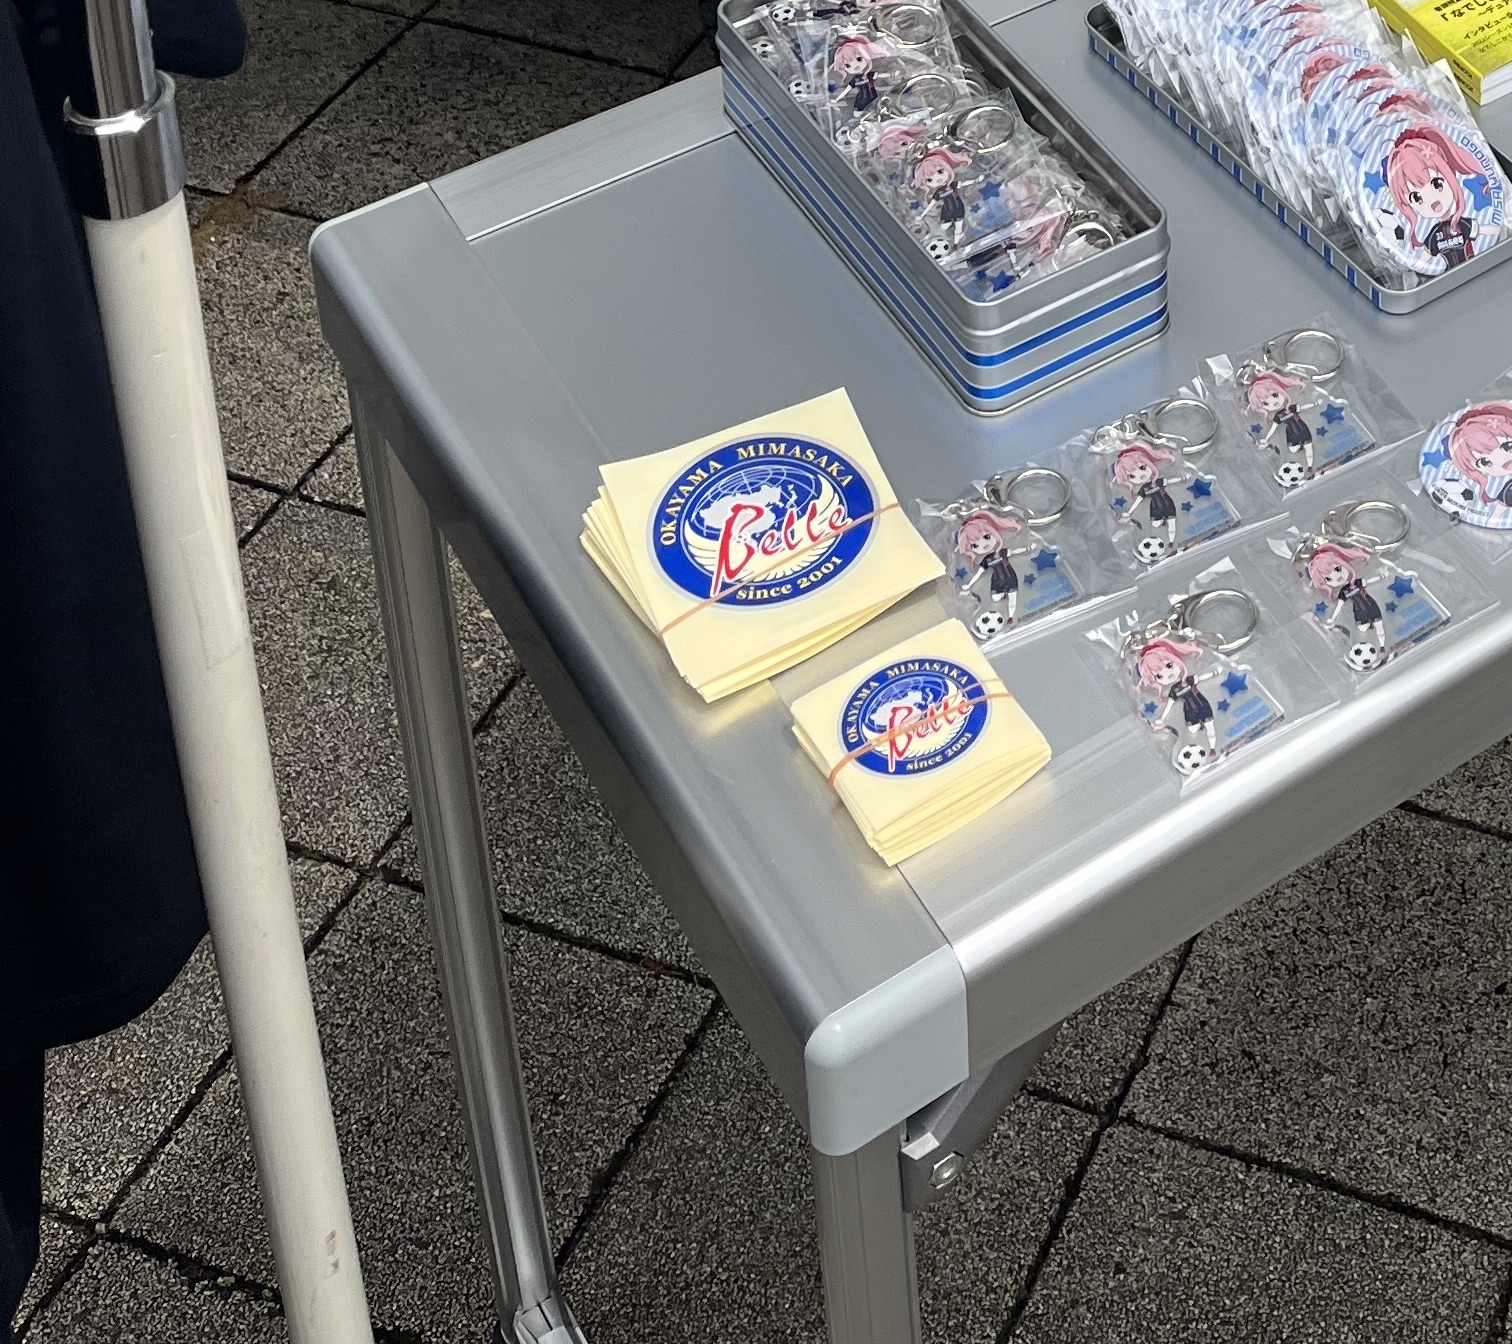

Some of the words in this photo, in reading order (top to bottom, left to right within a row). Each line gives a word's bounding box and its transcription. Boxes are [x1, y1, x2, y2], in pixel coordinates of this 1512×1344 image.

[659, 459, 724, 546] OKAYAMA
[736, 443, 854, 488] MIMASAKA
[709, 502, 854, 598] Belle
[735, 580, 793, 601] since
[797, 555, 844, 590] 2001
[847, 680, 880, 744] OKAYAMA
[887, 660, 970, 685] MIMASAKA
[887, 700, 974, 772] Belle
[905, 757, 943, 772] since
[944, 731, 974, 759] 2001
